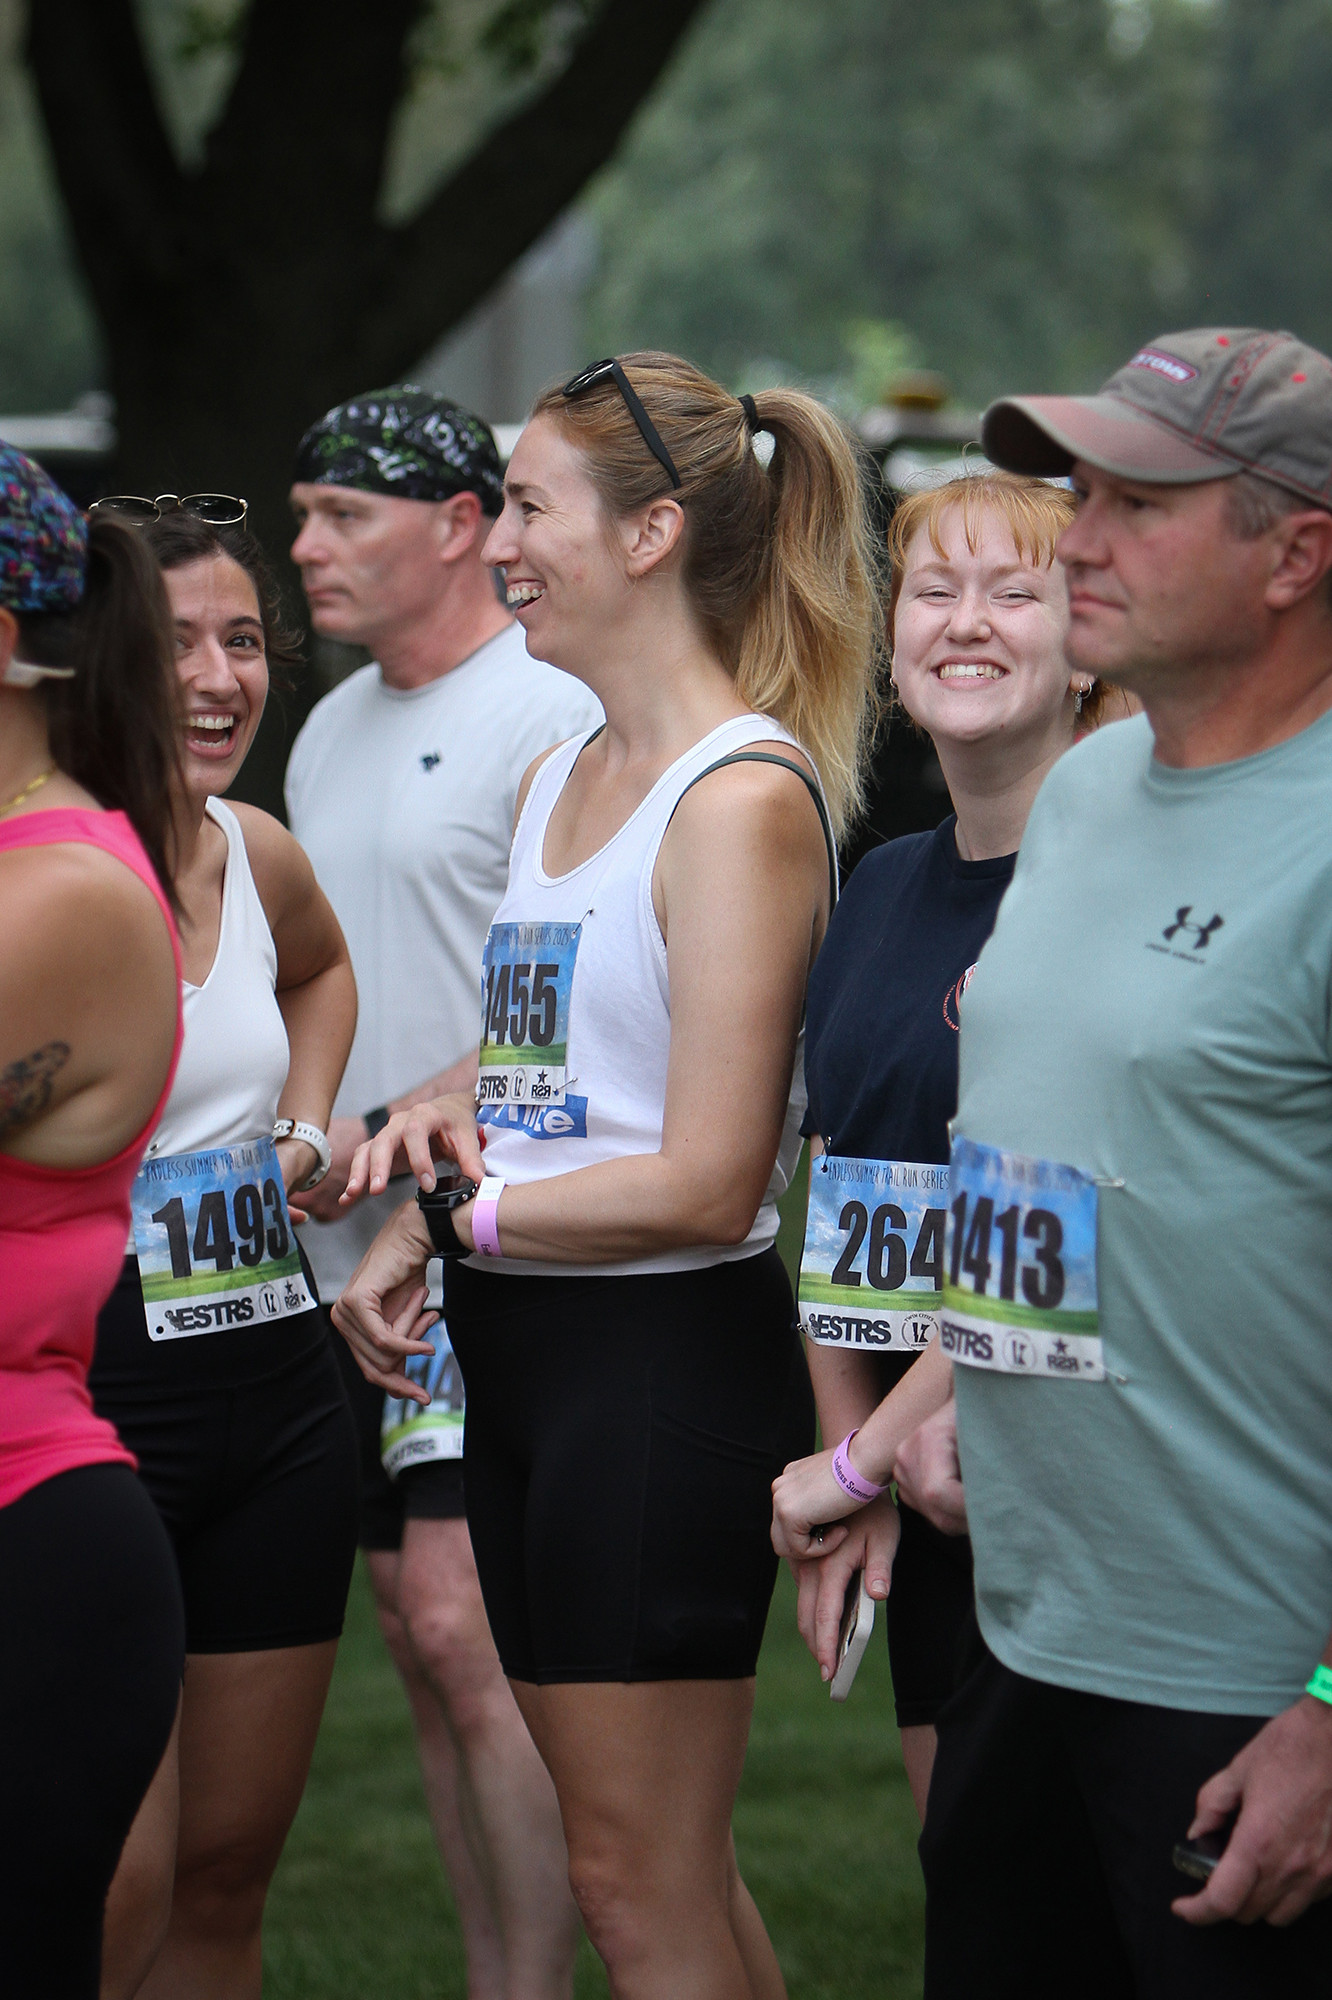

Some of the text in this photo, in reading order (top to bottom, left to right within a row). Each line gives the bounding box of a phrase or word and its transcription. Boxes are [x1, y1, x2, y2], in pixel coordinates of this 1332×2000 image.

[553, 927, 569, 946] 2025
[484, 964, 559, 1047] 1455
[145, 1159, 183, 1183] ENDLESS
[185, 1154, 219, 1178] SUMMER
[828, 1161, 950, 1190] ENDLESS SUMMER TRAIL RUN SERIES
[152, 1178, 289, 1279] 1493
[831, 1200, 946, 1291] 264
[949, 1190, 1066, 1310] 1413
[174, 1297, 255, 1332] ESTRS
[815, 1314, 892, 1345] ESTRS
[941, 1319, 993, 1361] ESTRS
